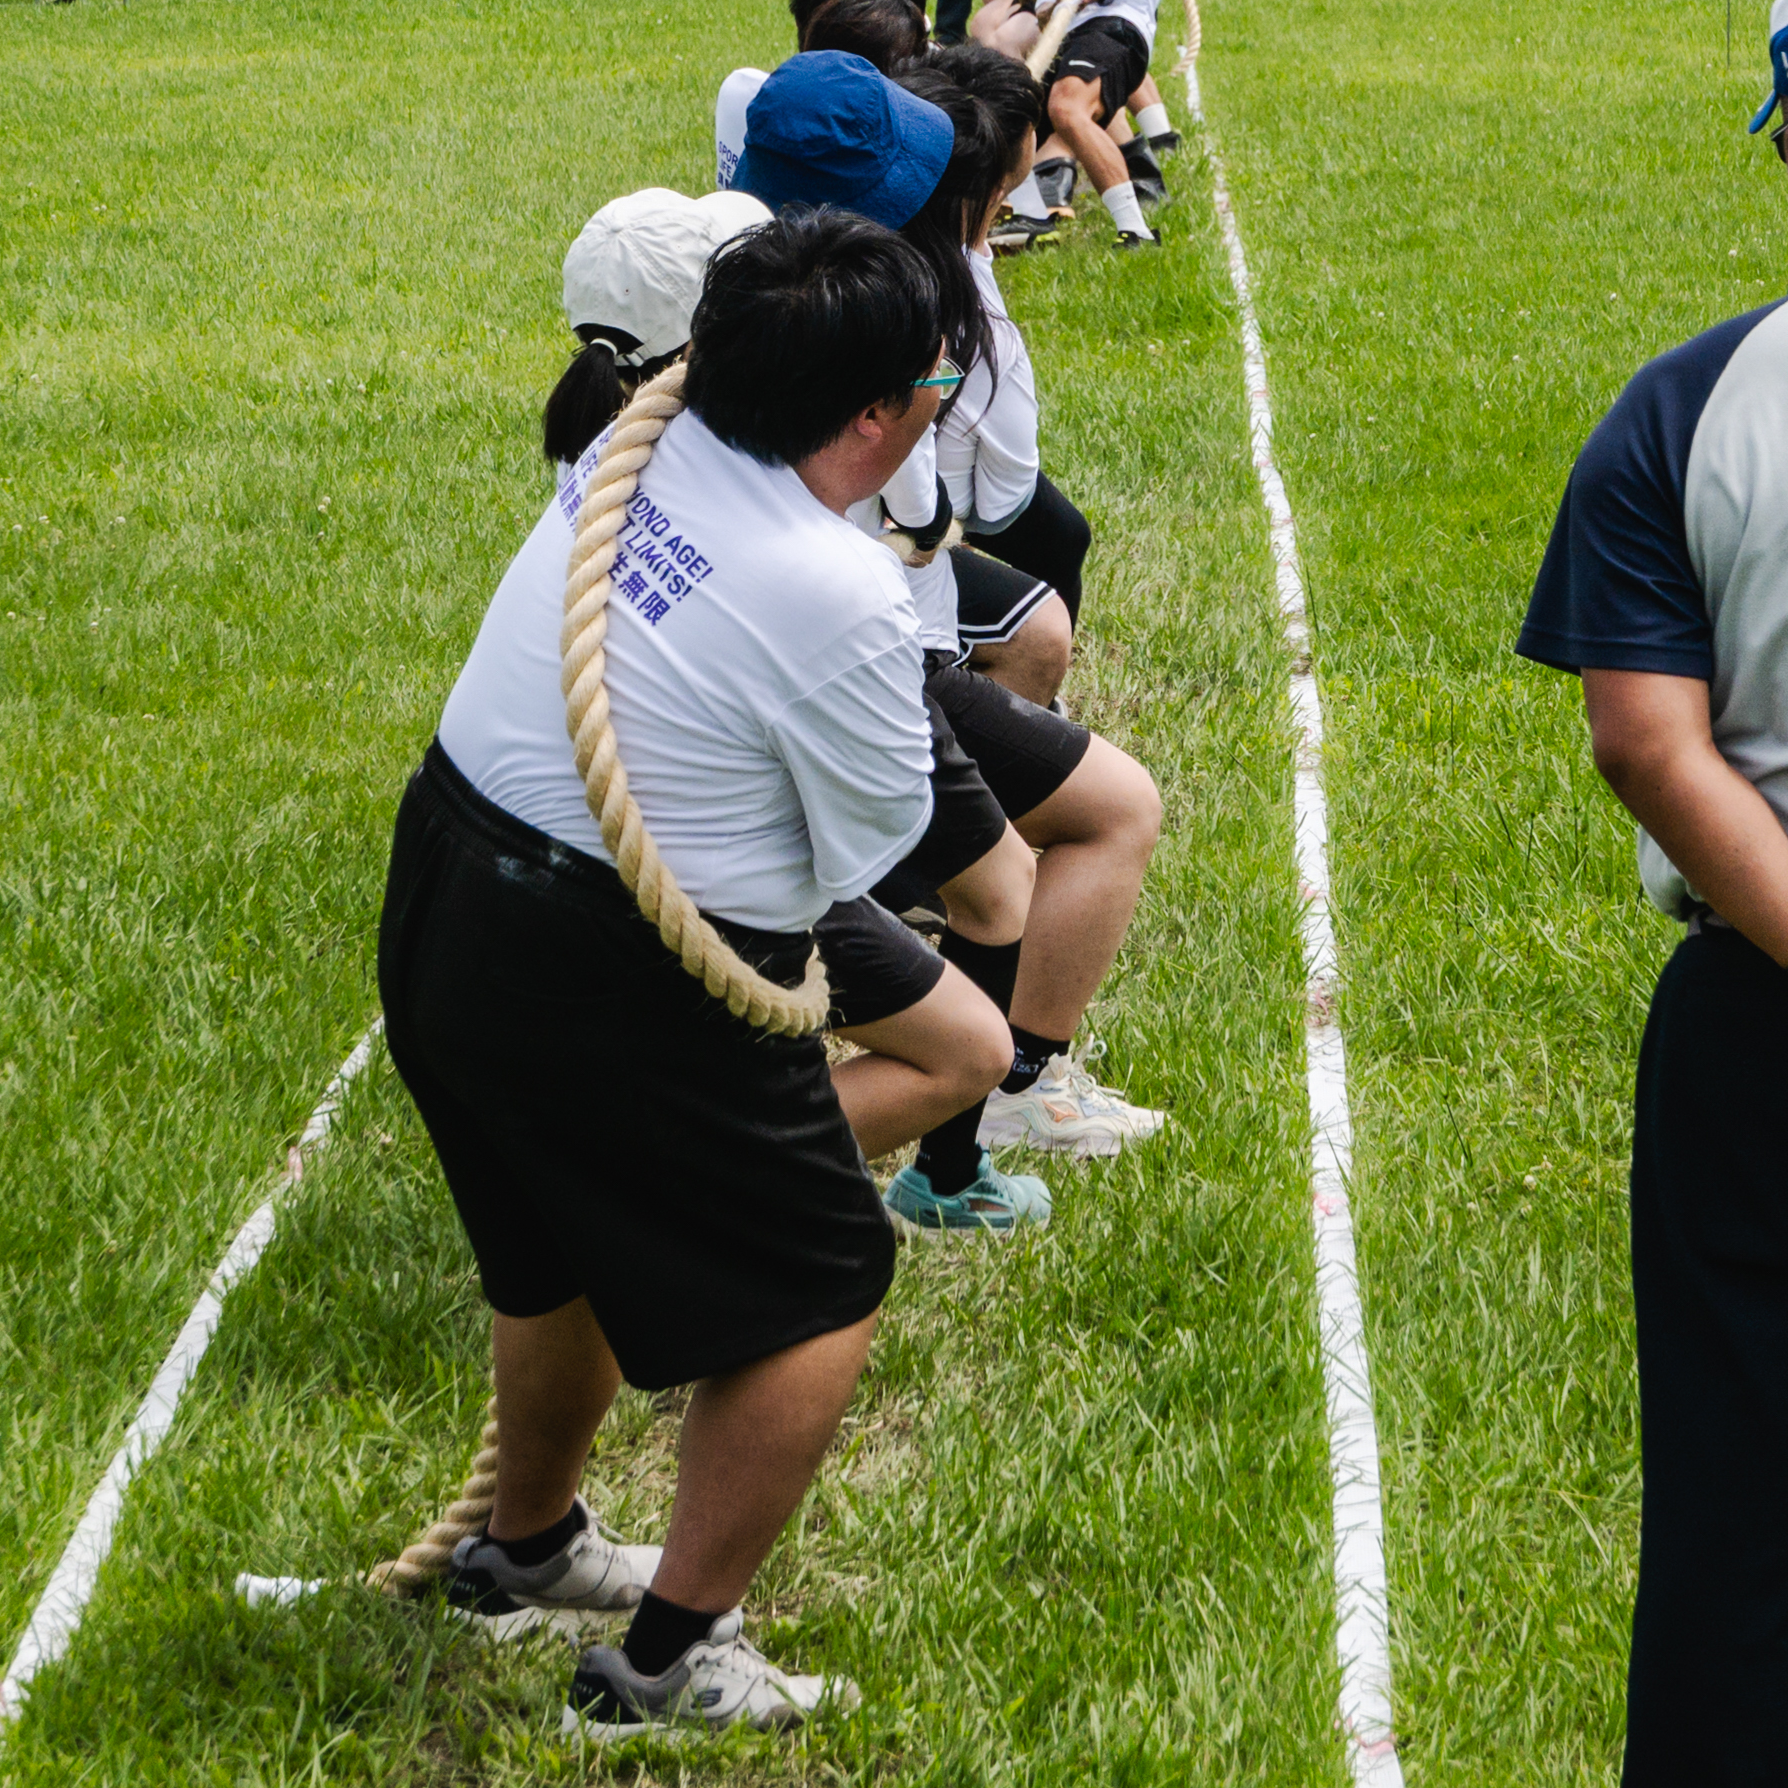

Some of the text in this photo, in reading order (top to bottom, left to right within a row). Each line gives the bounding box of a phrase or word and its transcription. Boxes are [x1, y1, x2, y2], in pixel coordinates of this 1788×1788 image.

[607, 550, 672, 627] 生無限
[624, 529, 694, 603] LIMITS!
[663, 534, 715, 584] AGE!
